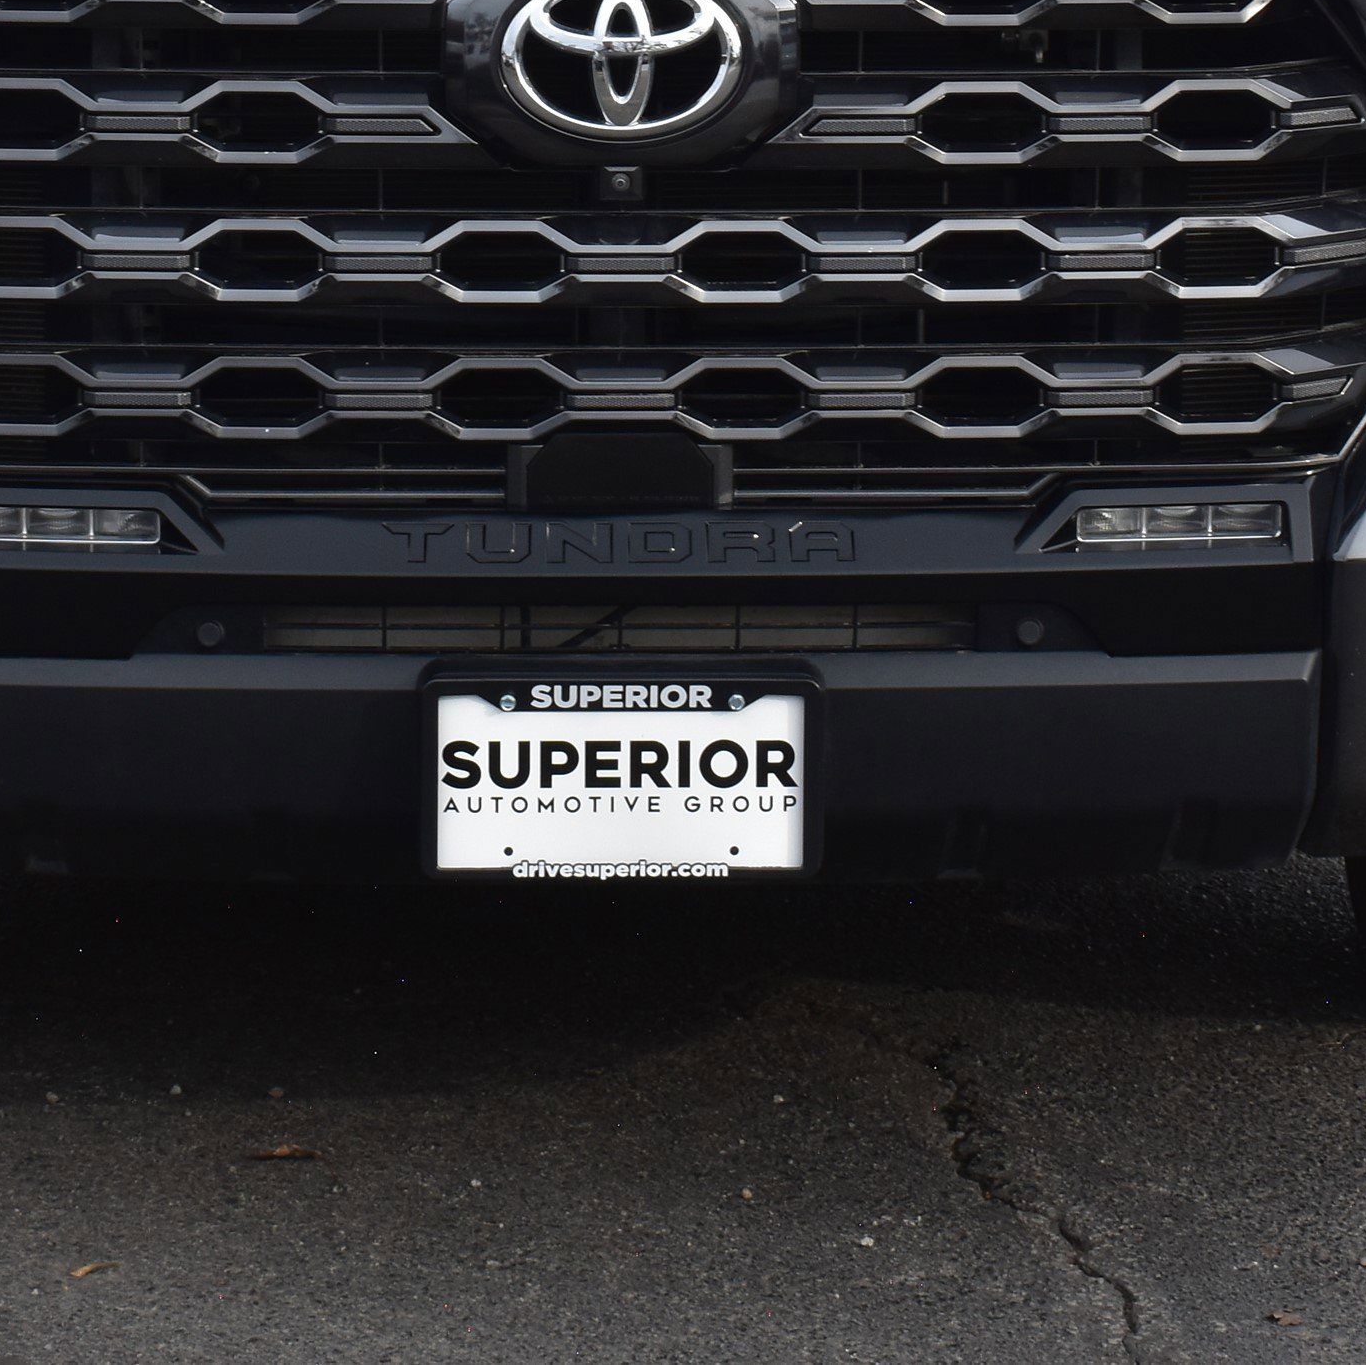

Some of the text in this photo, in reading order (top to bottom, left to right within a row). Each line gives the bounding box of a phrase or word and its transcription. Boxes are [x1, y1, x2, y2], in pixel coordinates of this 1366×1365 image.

[382, 521, 856, 564] TUNDRA
[529, 684, 713, 709] SUPERIOR
[440, 739, 799, 789] SUPERIOR
[443, 795, 798, 813] AUTOMOTIVE GROUP
[511, 860, 730, 880] drivesuperior.com
